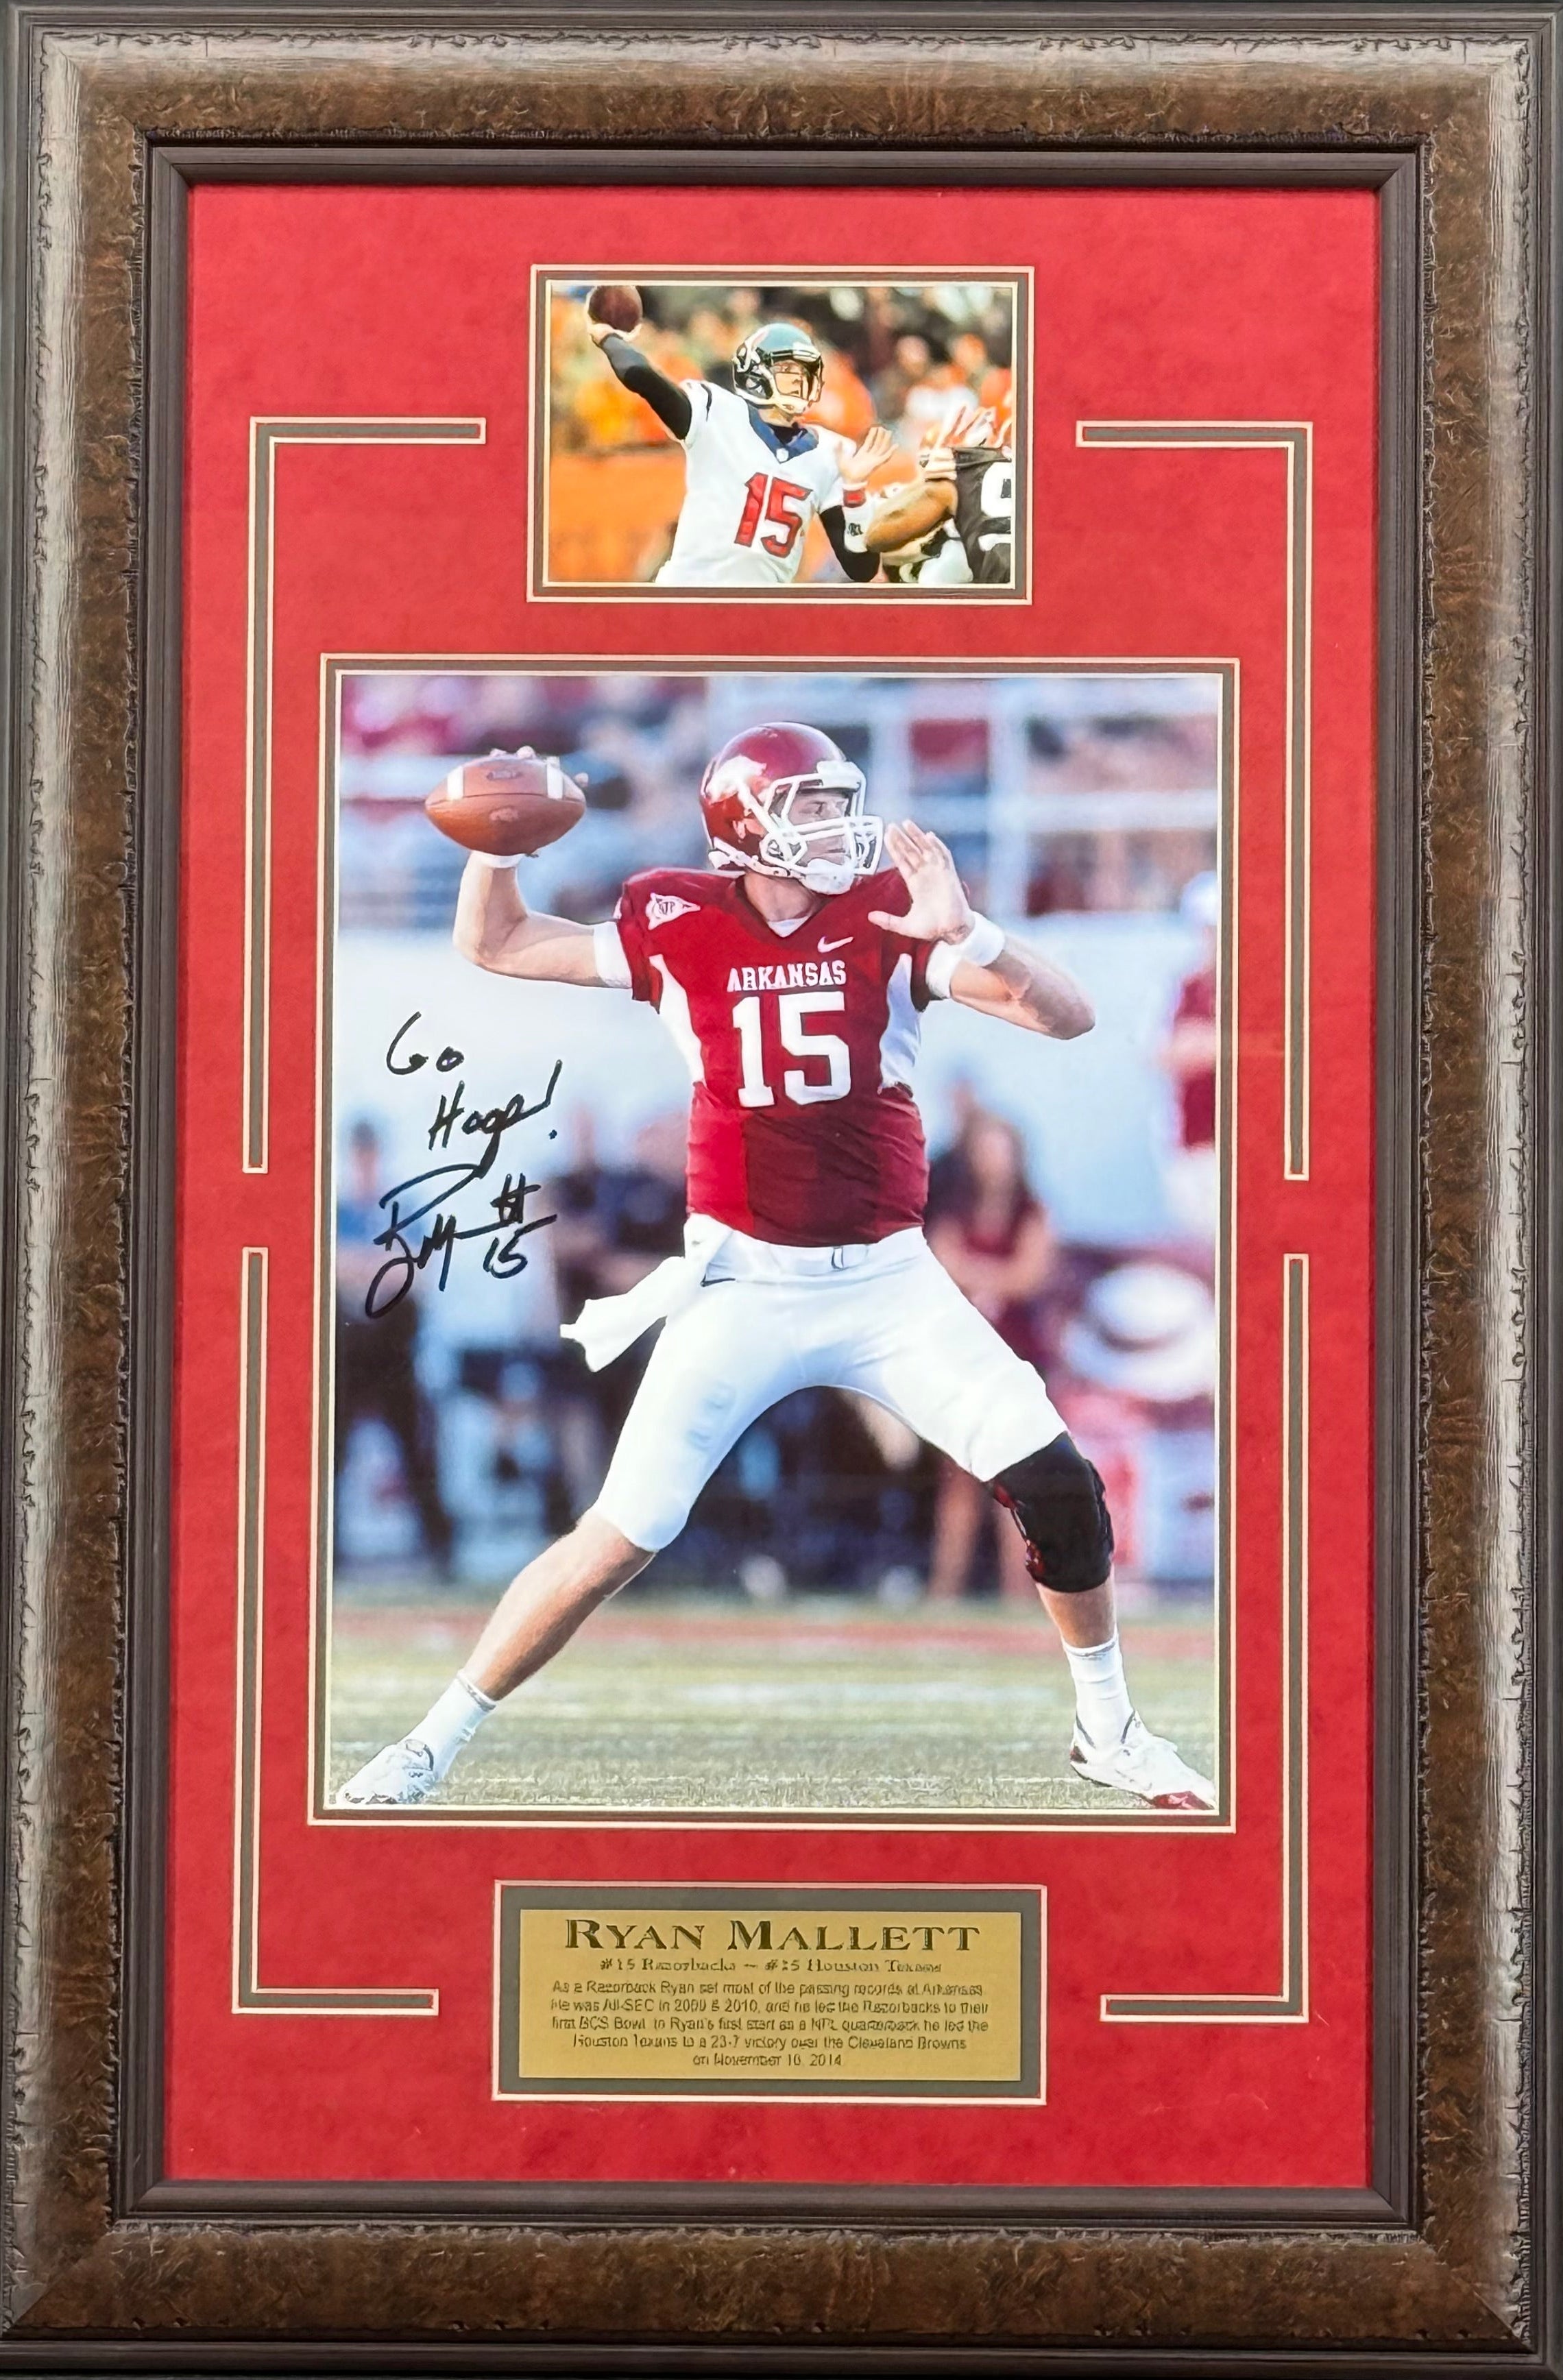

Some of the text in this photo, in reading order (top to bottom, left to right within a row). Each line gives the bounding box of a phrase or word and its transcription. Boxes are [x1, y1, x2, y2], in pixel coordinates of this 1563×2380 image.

[734, 472, 813, 558] 15
[727, 960, 847, 992] ARKANSAS
[386, 1011, 465, 1075] Go
[731, 991, 851, 1108] 15
[565, 1919, 980, 1951] RYAN MALLETT
[807, 1958, 880, 1972] Houston
[553, 1980, 569, 1993] As
[574, 1982, 583, 1993] a
[586, 1980, 657, 1994] Razorback
[660, 1980, 694, 1996] Ryan
[699, 1981, 718, 1993] set
[723, 1981, 754, 1994] most
[758, 1980, 772, 1993] of
[775, 1981, 795, 1994] the
[799, 1982, 850, 1997] passing
[853, 1982, 903, 1995] records
[907, 1982, 919, 1995] at
[550, 1998, 570, 2011] He
[573, 2000, 600, 2012] was
[659, 1998, 670, 2012] in
[765, 2000, 789, 2013] and
[794, 2000, 810, 2013] he
[814, 2000, 836, 2013] led
[838, 2000, 858, 2013] the
[862, 2000, 941, 2014] Razorbacks
[944, 2000, 956, 2014] to
[960, 2000, 989, 2015] their
[551, 2016, 577, 2030] first
[579, 2015, 609, 2030] BCS
[670, 2016, 714, 2032] Ryan's
[718, 2017, 742, 2030] first
[746, 2017, 775, 2030] start
[779, 2019, 794, 2031] as
[799, 2019, 806, 2031] a
[811, 2017, 838, 2032] NFL
[841, 2018, 921, 2034] quarterback
[923, 2019, 940, 2032] he
[944, 2019, 964, 2032] led
[967, 2019, 989, 2032] the
[573, 2033, 967, 2051] Houston Texans to a 23-7 victory over the Cleveland Browns
[692, 2054, 710, 2065] on
[714, 2052, 782, 2066] November
[809, 2053, 842, 2067] 2014
